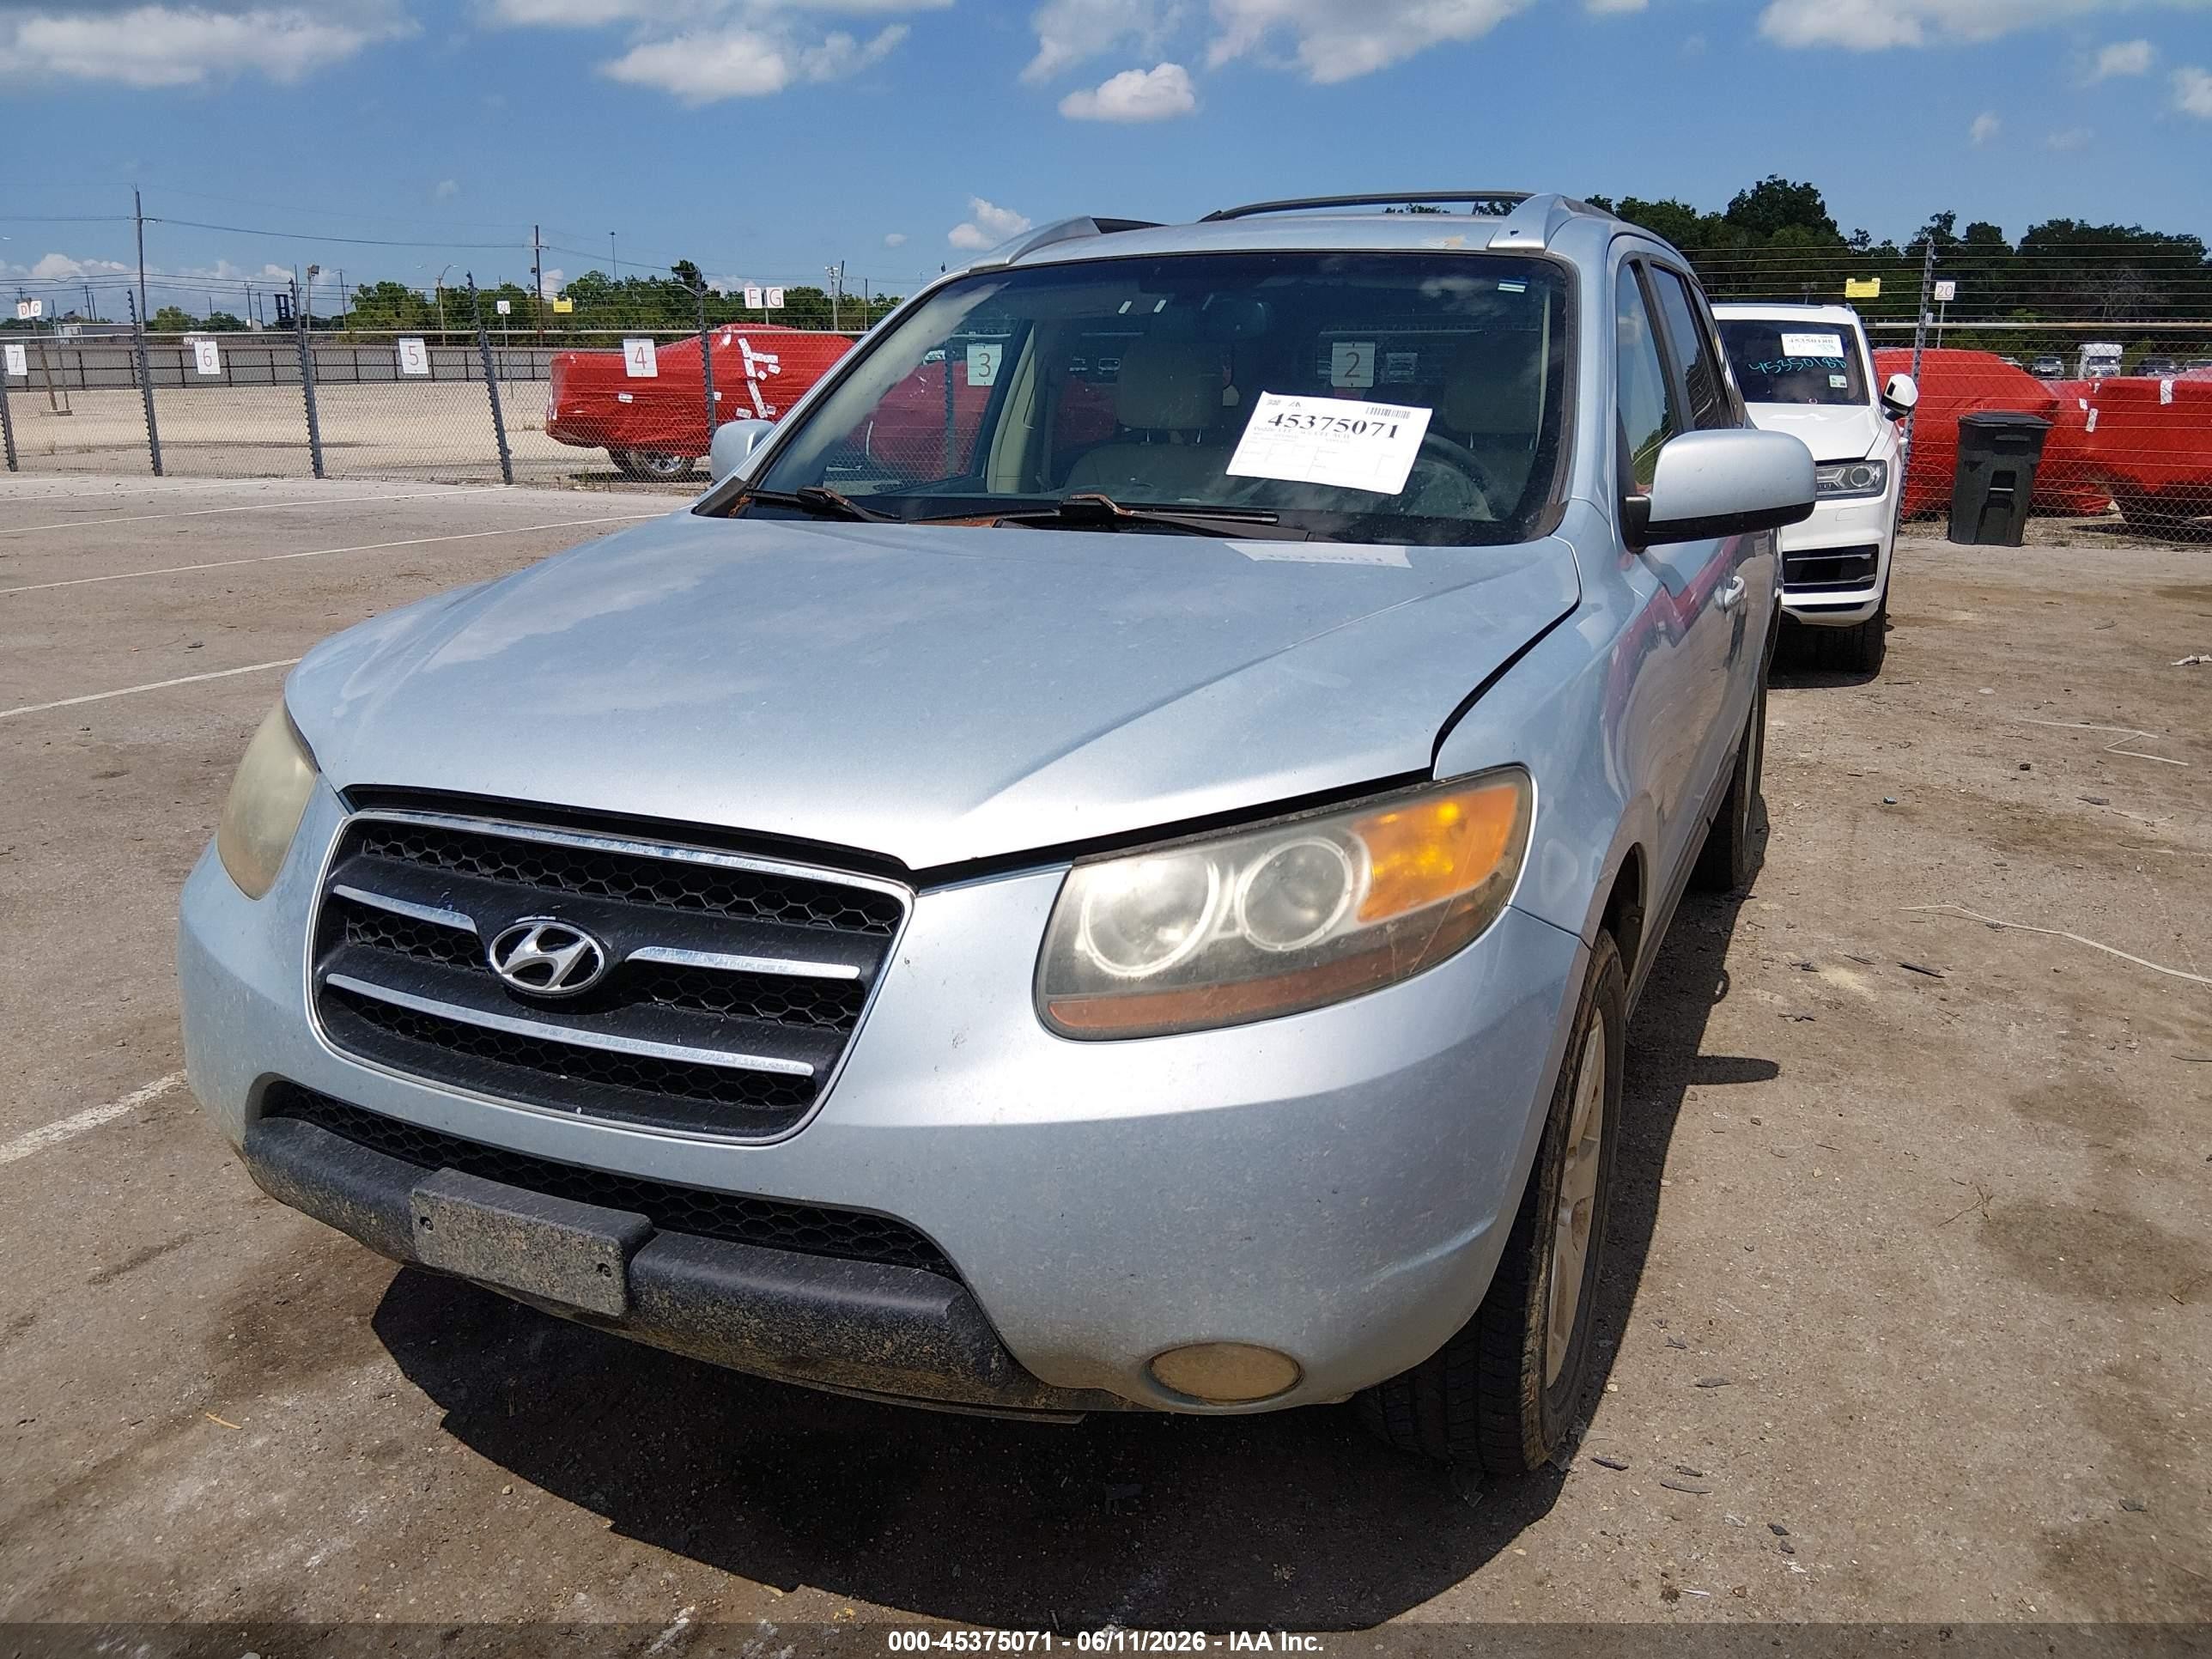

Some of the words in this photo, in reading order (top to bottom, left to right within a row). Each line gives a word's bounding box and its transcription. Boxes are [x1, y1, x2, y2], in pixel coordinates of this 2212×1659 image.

[748, 288, 757, 307] F
[769, 289, 782, 307] G
[1936, 285, 1954, 297] 20
[20, 305, 29, 317] D
[33, 302, 40, 314] C
[498, 303, 509, 313] 20
[11, 350, 20, 368] 7
[203, 347, 213, 368] 6
[408, 345, 419, 366] 5
[634, 346, 647, 369] 4
[977, 352, 991, 378] 3
[1345, 351, 1360, 378] 2
[1267, 412, 1400, 439] 45375071
